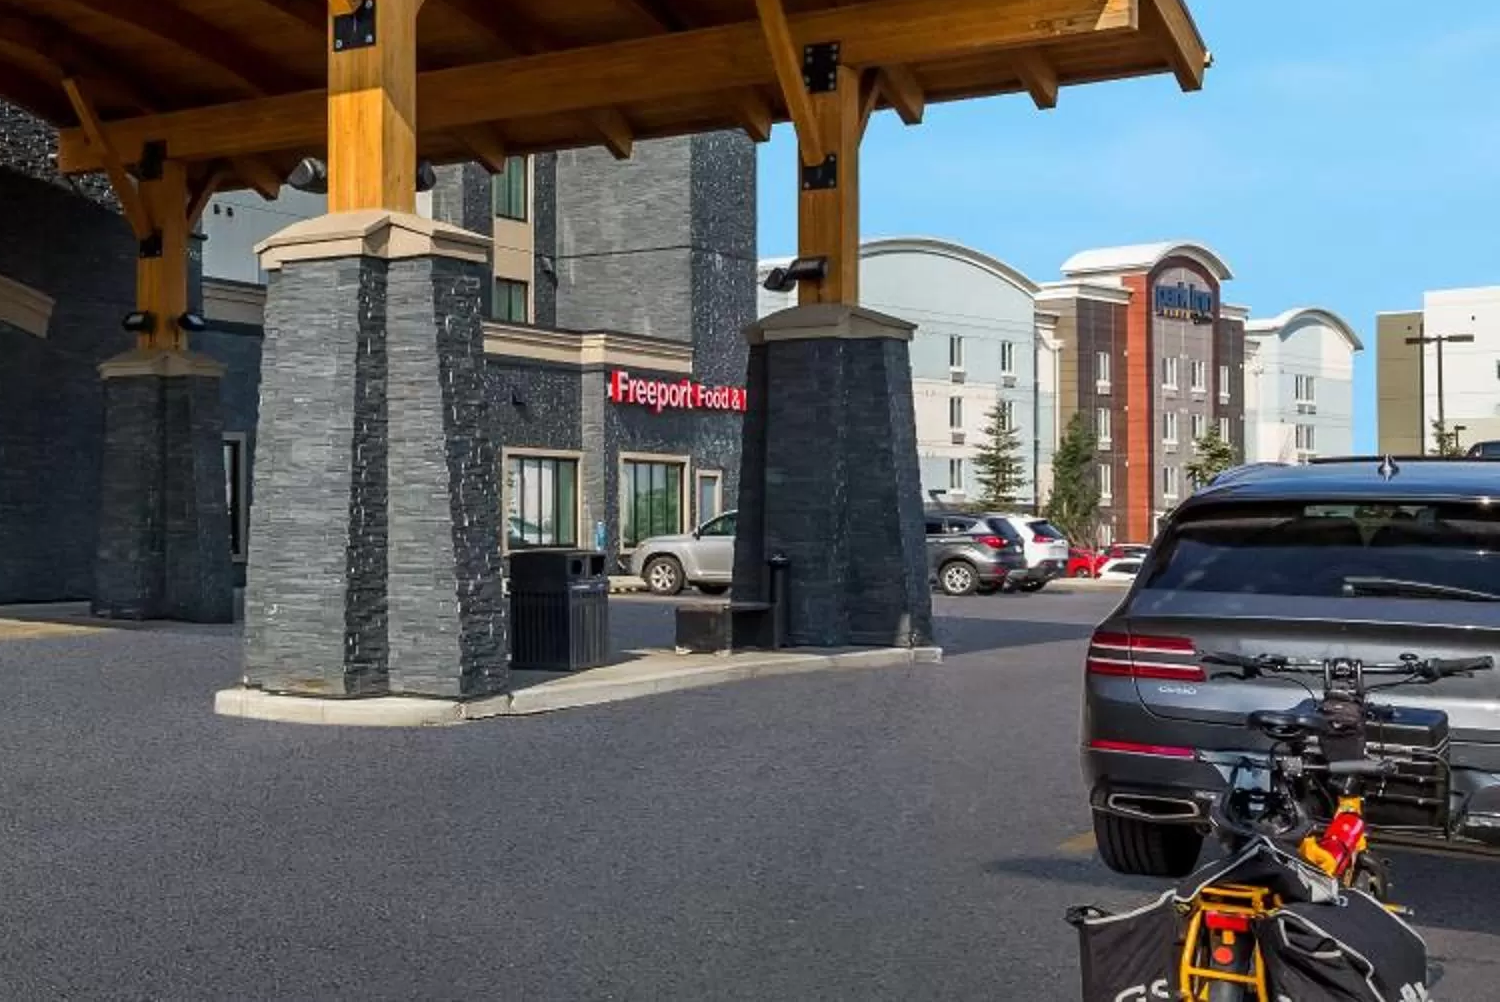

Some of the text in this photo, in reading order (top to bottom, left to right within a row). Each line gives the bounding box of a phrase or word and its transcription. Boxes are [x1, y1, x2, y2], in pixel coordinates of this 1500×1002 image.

[614, 371, 693, 413] Freeport
[698, 385, 730, 409] Food
[731, 388, 741, 410] &
